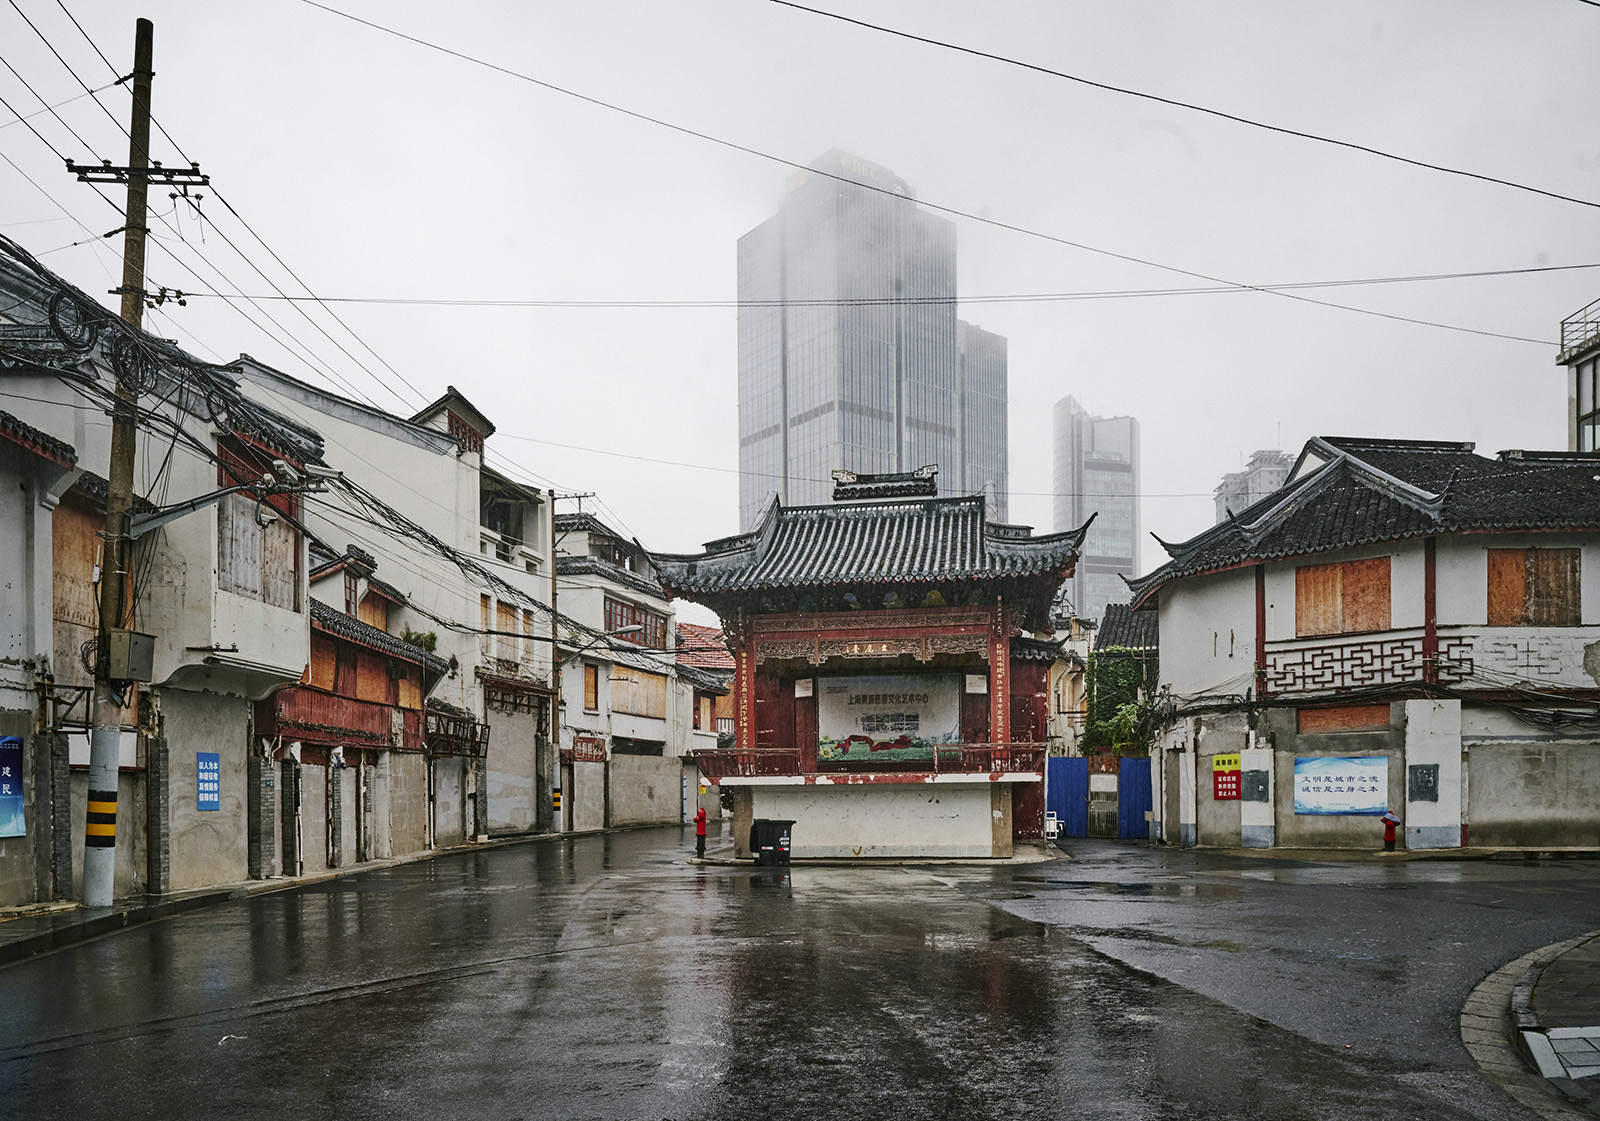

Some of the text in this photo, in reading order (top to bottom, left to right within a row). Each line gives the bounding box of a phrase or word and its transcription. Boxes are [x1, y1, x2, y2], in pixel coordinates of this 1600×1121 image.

[853, 159, 879, 181] BFC
[848, 693, 929, 706] 上海黄浦慈善文化艺术中心
[199, 761, 219, 770] 以人为本
[1215, 758, 1239, 766] 温馨提示
[1, 766, 12, 778] 建
[199, 771, 219, 780] 和谐征收
[1301, 775, 1379, 783] 文明是城市之魂
[2, 783, 12, 795] 民
[199, 782, 219, 791] 真情服务
[1301, 785, 1379, 793] 诚信是立身之本
[199, 793, 219, 802] 保障权益
